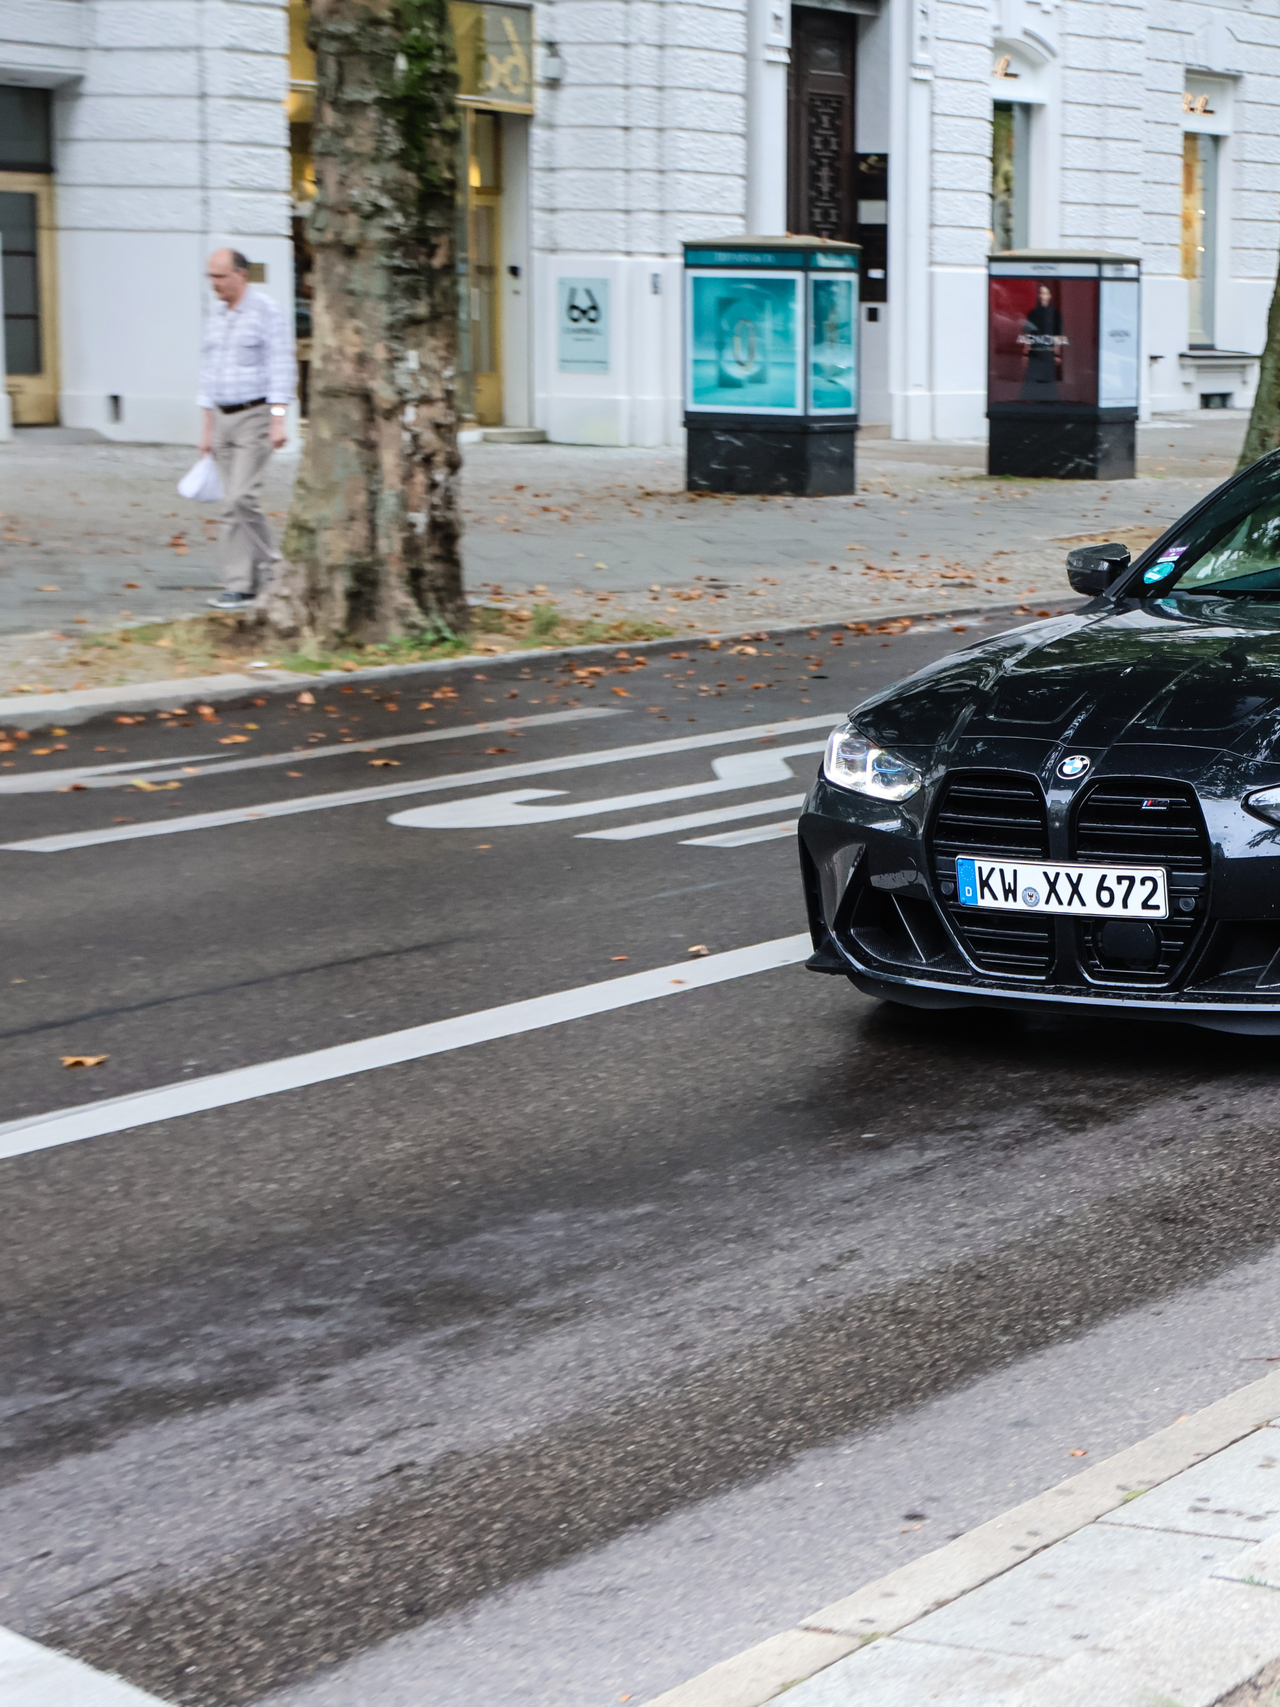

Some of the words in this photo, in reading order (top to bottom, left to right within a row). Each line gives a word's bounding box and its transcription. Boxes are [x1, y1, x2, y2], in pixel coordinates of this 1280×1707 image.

[965, 886, 973, 897] D
[977, 866, 1018, 903] KW
[1042, 871, 1087, 907] XX
[1095, 874, 1161, 911] 672
